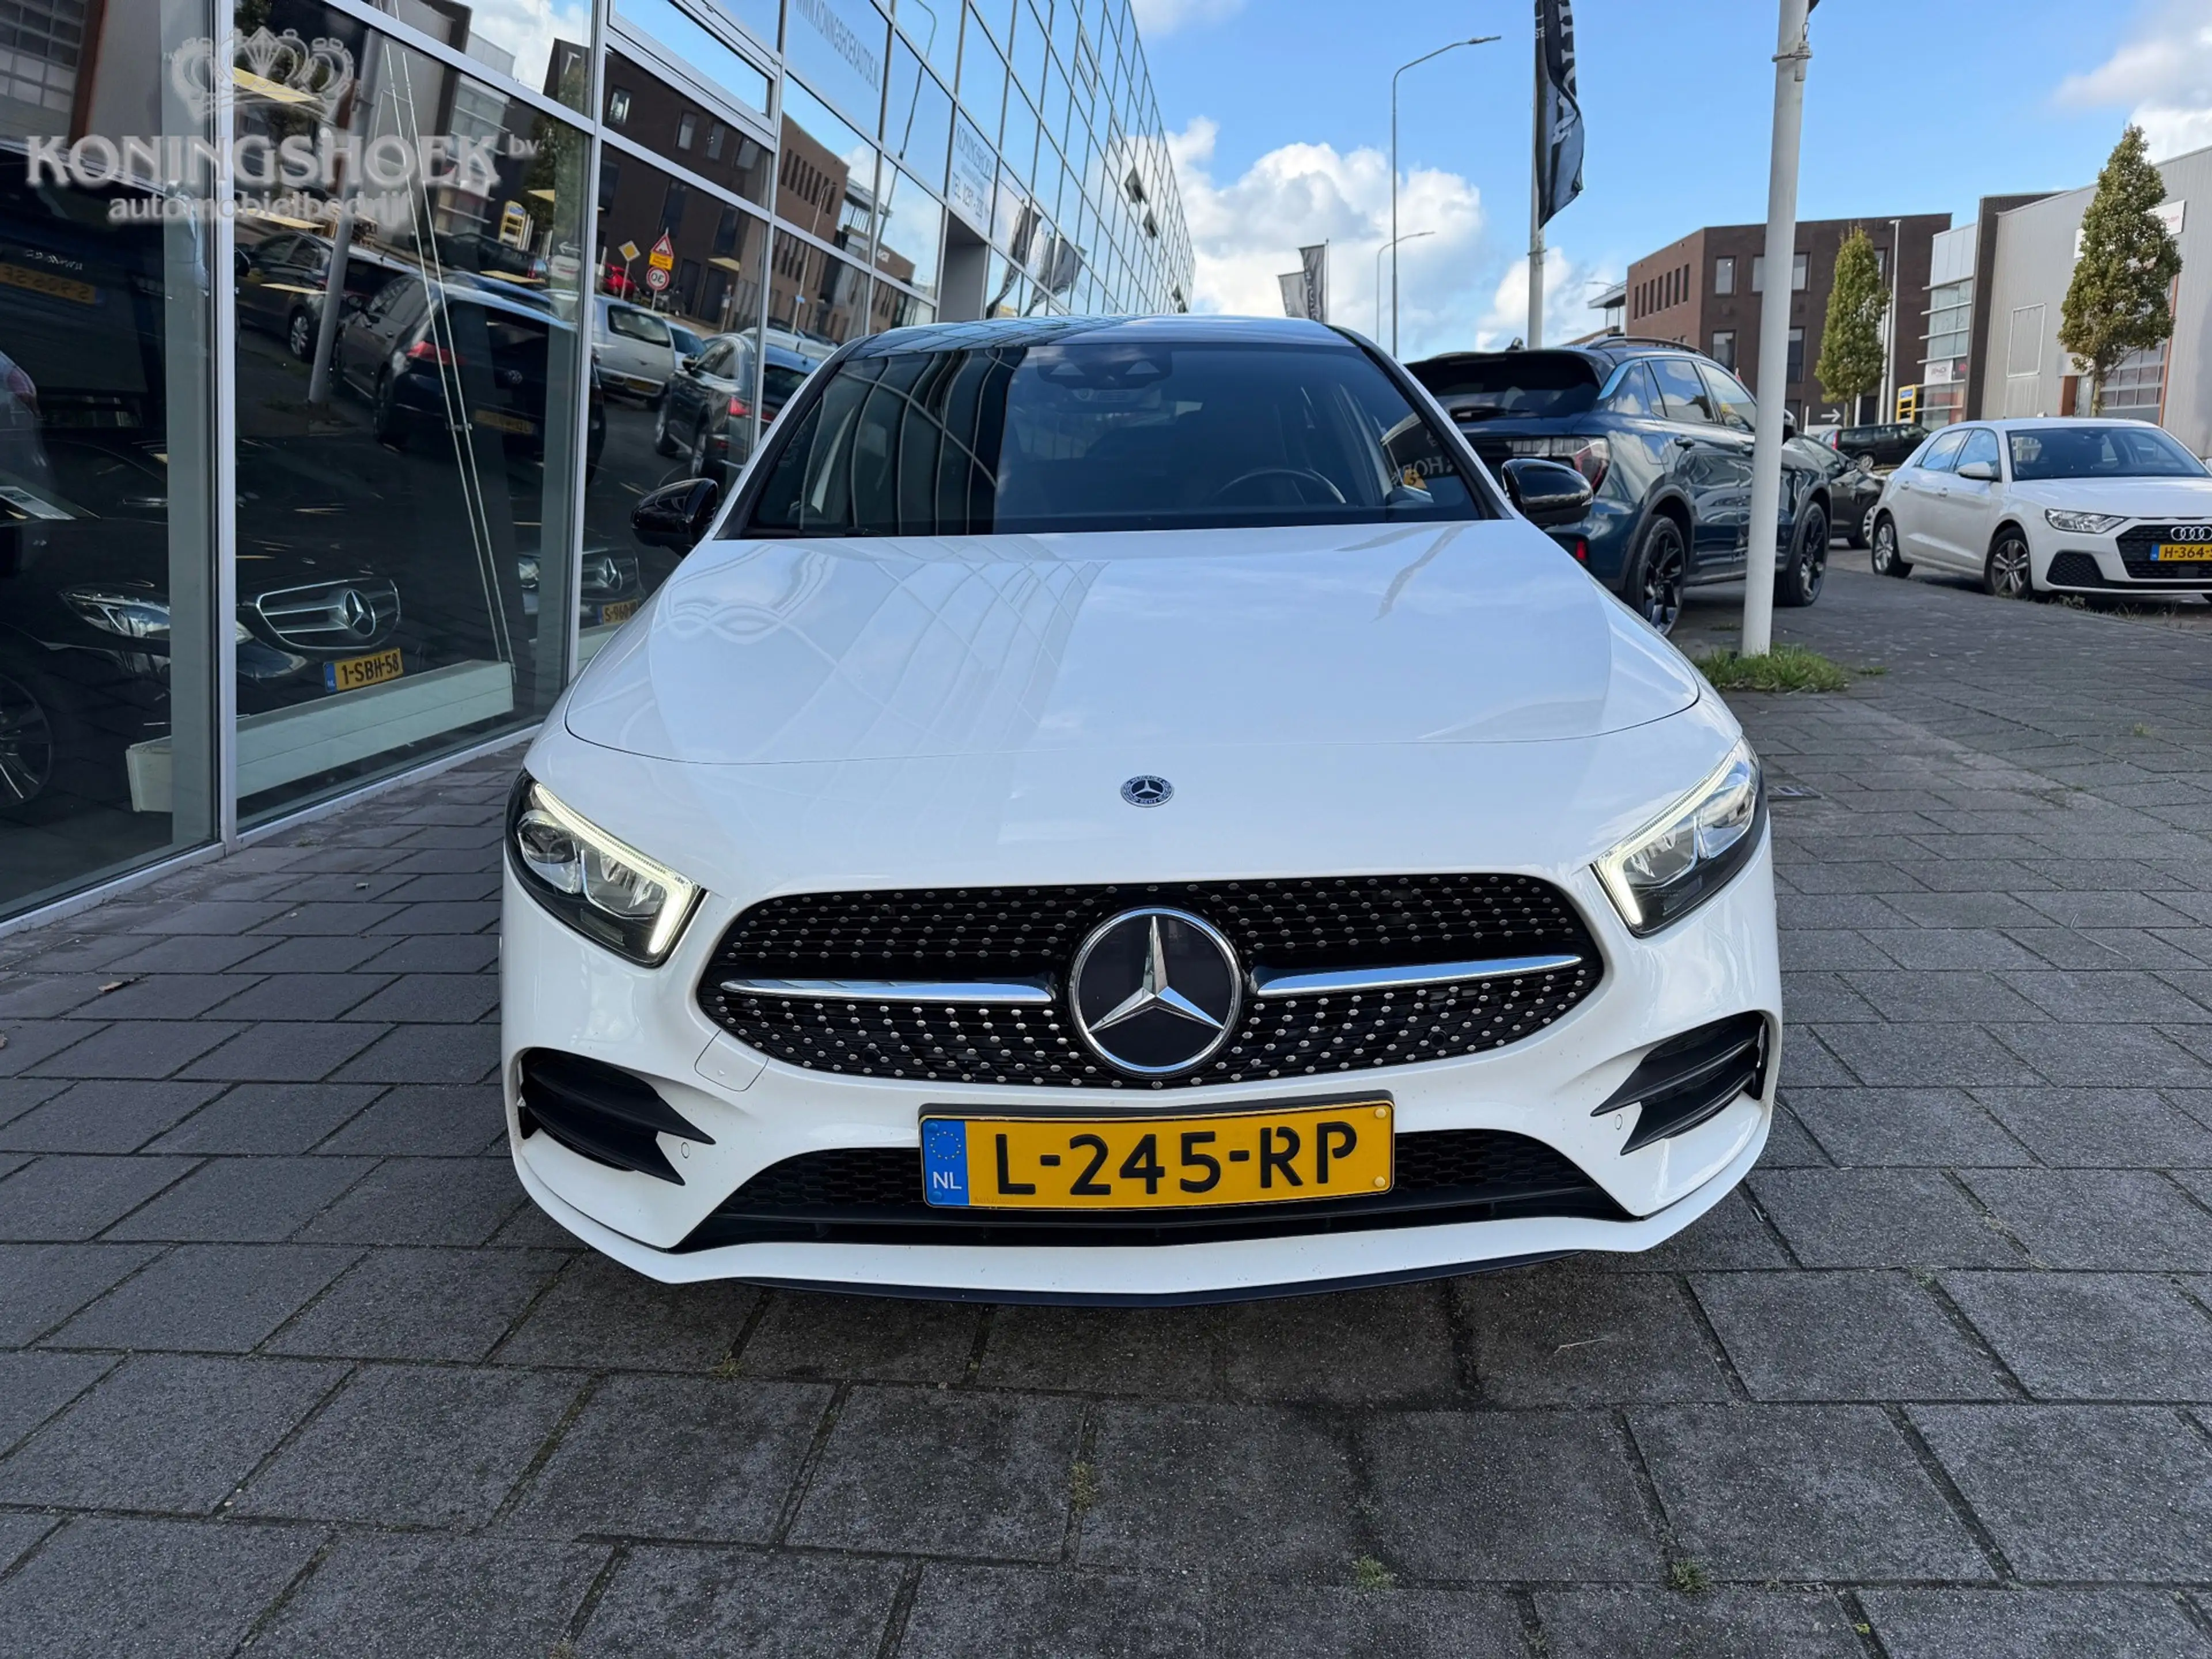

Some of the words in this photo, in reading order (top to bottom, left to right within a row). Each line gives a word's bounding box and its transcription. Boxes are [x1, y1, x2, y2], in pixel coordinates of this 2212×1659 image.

[342, 653, 399, 685] 1-SBH-58
[933, 1171, 962, 1189] NL
[995, 1121, 1357, 1195] L-245-RP
